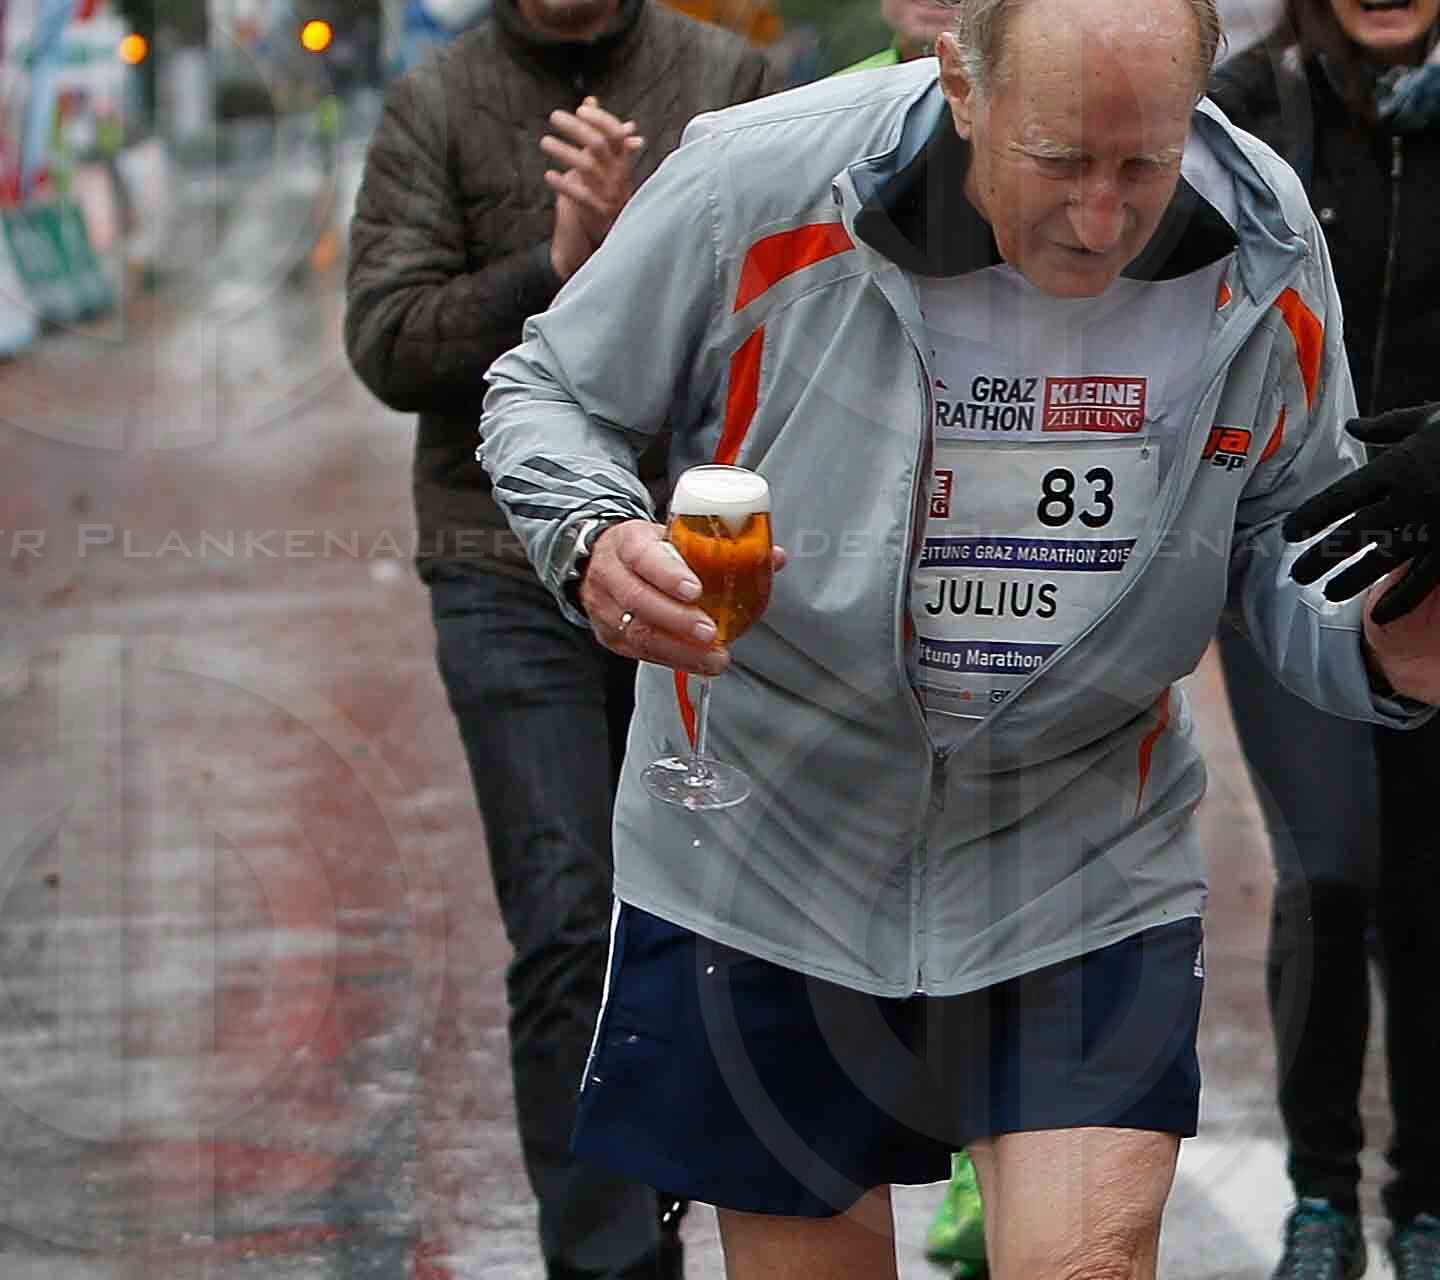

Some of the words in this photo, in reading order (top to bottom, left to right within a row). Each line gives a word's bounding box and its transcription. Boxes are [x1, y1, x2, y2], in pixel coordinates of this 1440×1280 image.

[971, 376, 1036, 404] GRAZ
[1049, 382, 1142, 406] KLEINE
[935, 401, 1035, 432] RATHON
[1046, 409, 1141, 429] ZEITUNG
[1036, 466, 1114, 529] 83
[919, 543, 971, 561] EITUNG
[974, 544, 1014, 561] GRAZ
[1016, 545, 1096, 564] MARATHON
[1099, 547, 1130, 564] 2015
[925, 577, 1058, 619] JULIUS
[919, 644, 962, 669] itung
[965, 646, 1043, 669] Marathon
